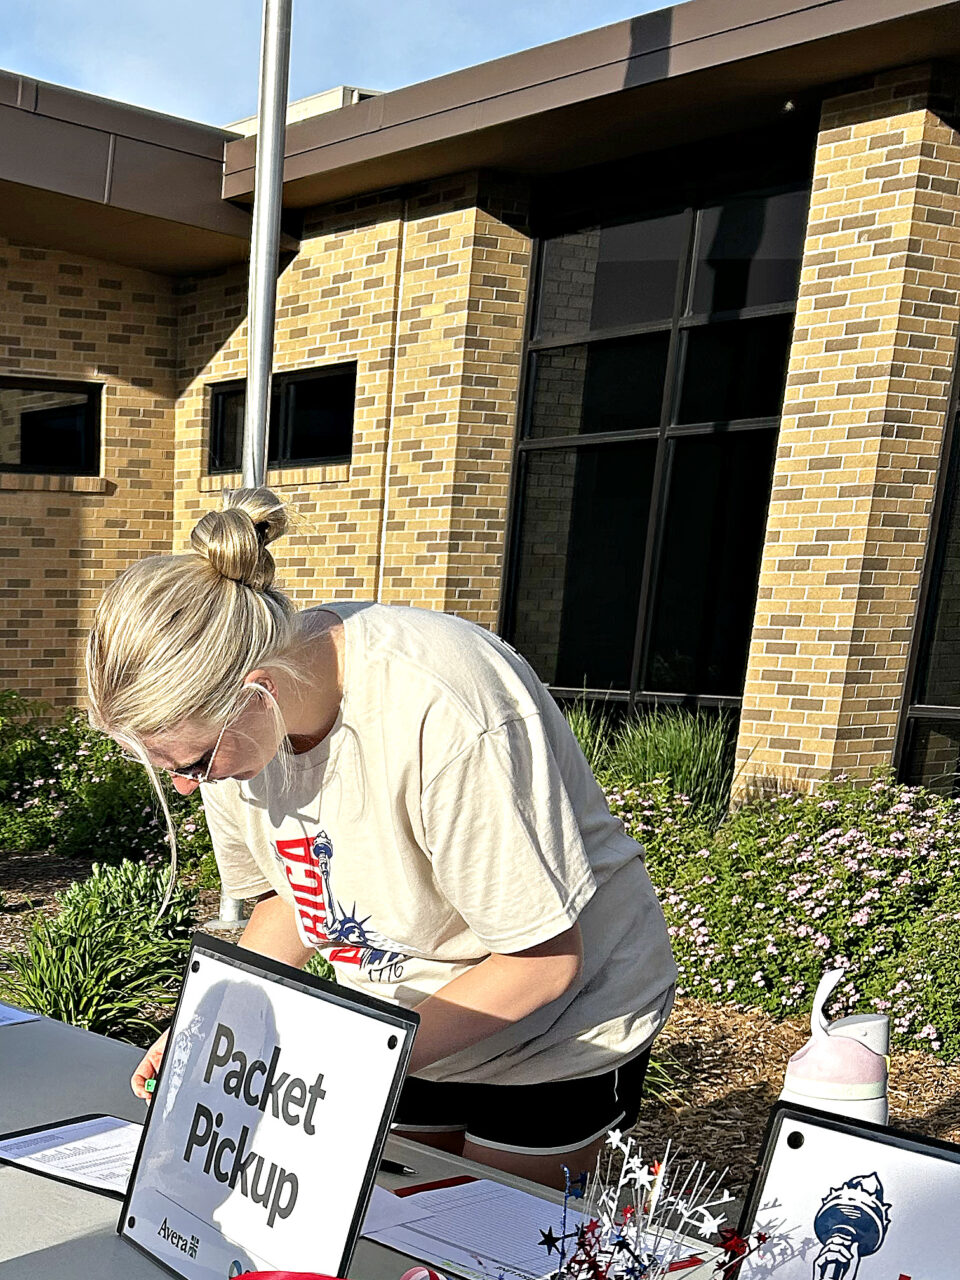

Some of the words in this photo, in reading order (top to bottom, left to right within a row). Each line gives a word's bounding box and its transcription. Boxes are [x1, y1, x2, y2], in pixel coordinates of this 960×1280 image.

[204, 1023, 326, 1136] Packet
[183, 1102, 299, 1228] Pickup
[157, 1217, 189, 1253] Avera
